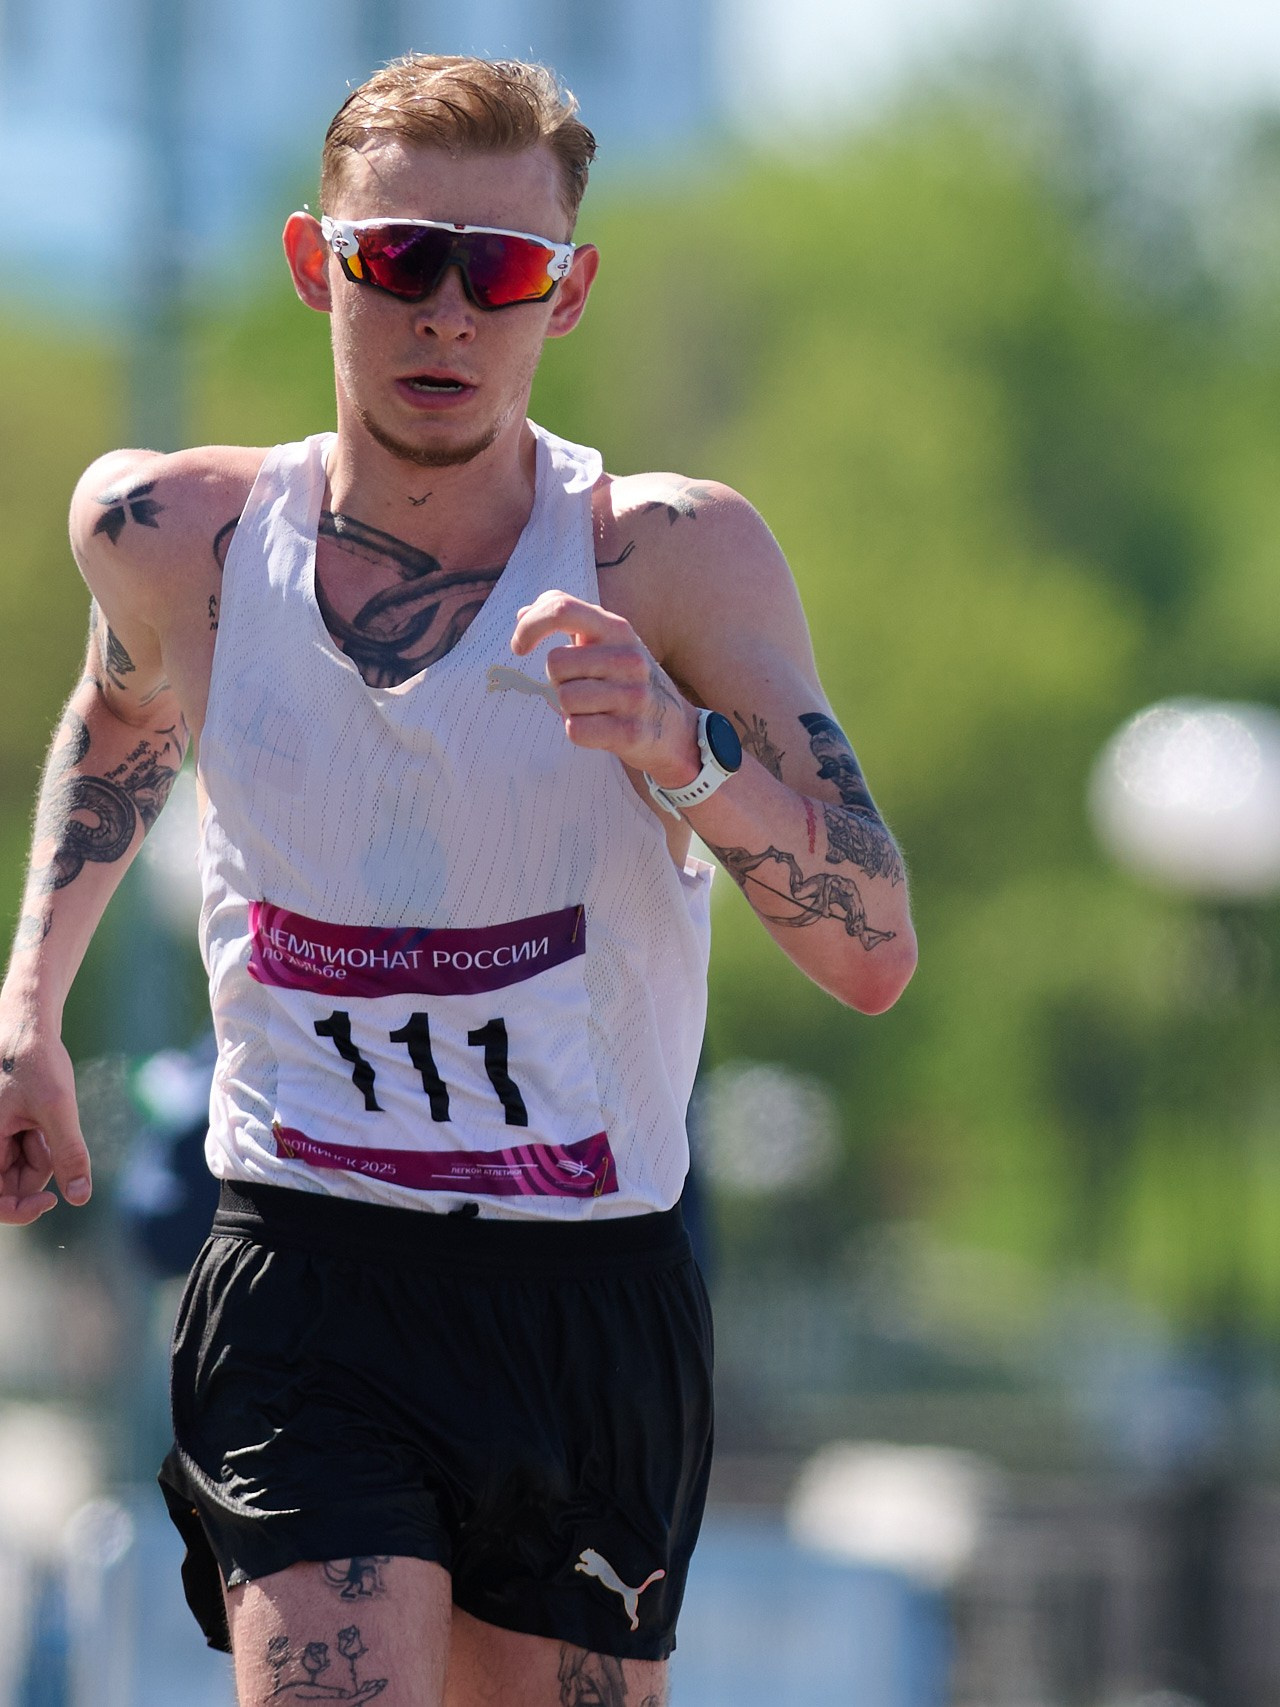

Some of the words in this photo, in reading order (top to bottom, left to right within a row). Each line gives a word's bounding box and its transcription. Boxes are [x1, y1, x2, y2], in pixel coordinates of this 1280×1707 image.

[261, 926, 423, 969] ЧЕМПИОНАТ
[432, 936, 549, 970] РОССИИ
[262, 947, 284, 961] по
[314, 1010, 528, 1127] 111
[360, 1160, 397, 1176] 2025
